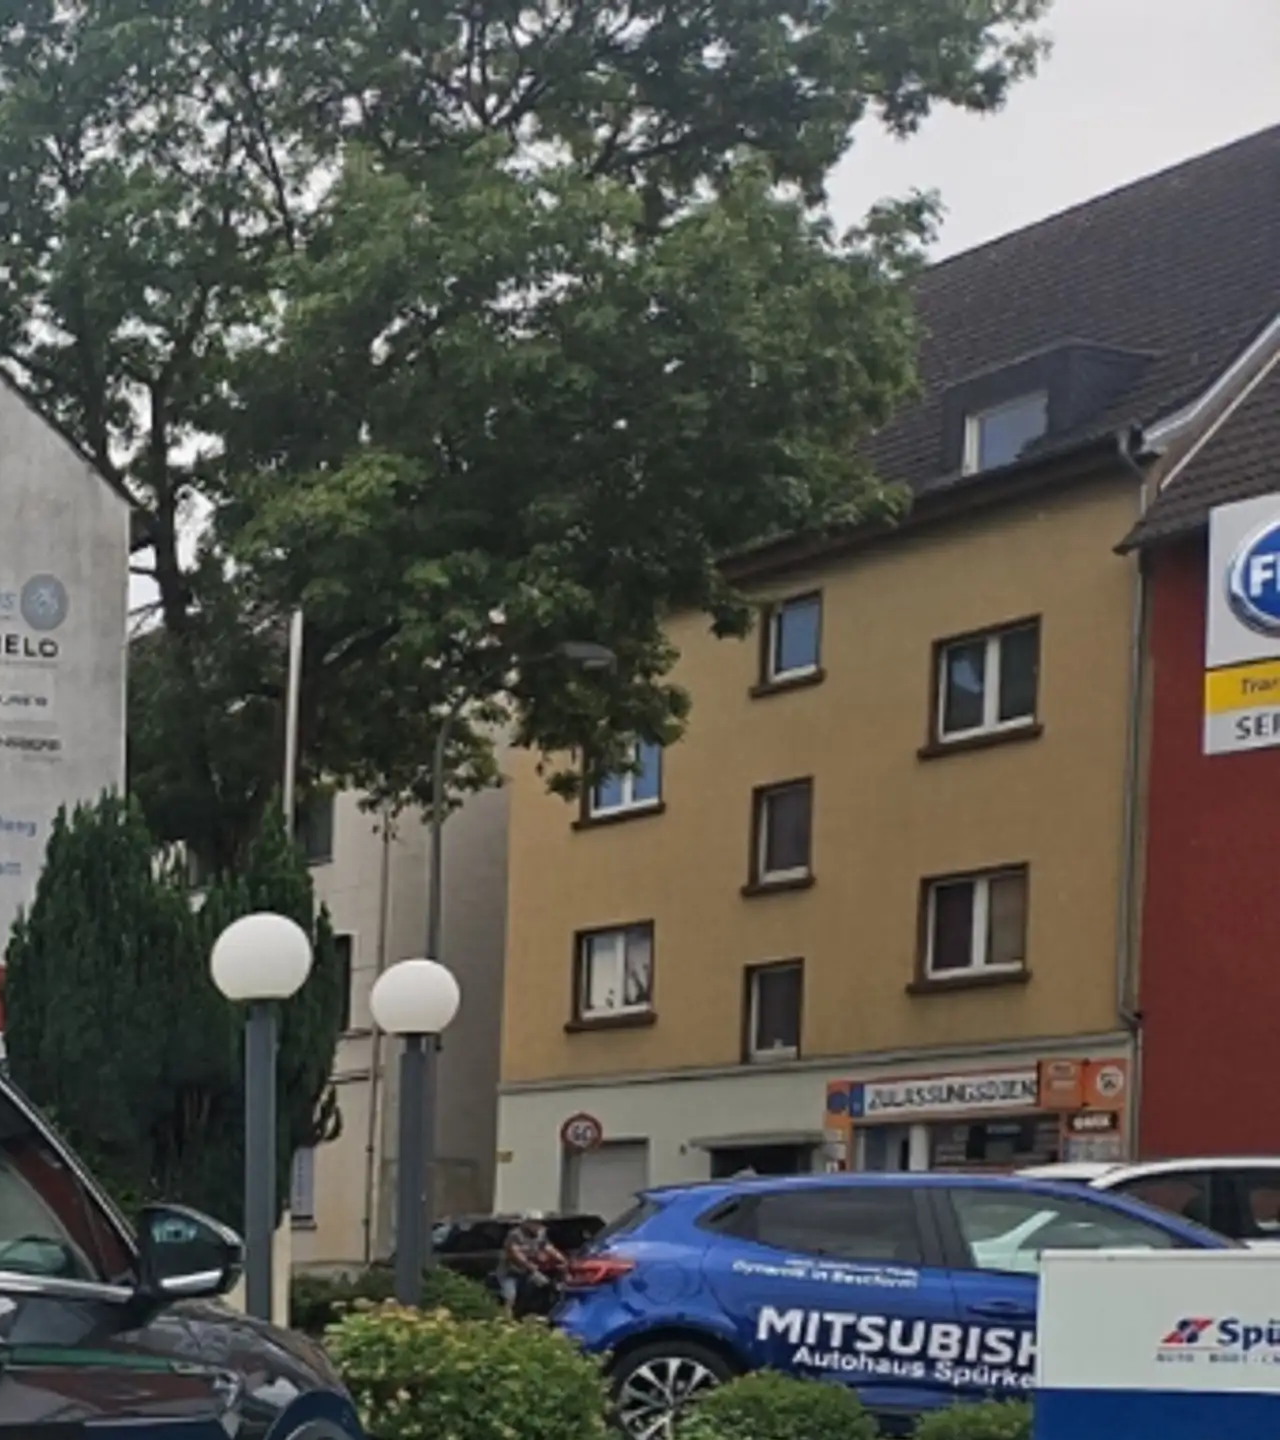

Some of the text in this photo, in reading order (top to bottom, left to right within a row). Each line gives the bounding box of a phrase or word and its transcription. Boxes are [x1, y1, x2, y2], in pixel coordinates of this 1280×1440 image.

[1249, 553, 1280, 597] F
[757, 1306, 1038, 1368] MITSUBISH
[792, 1346, 1037, 1390] Autohaus Spürke
